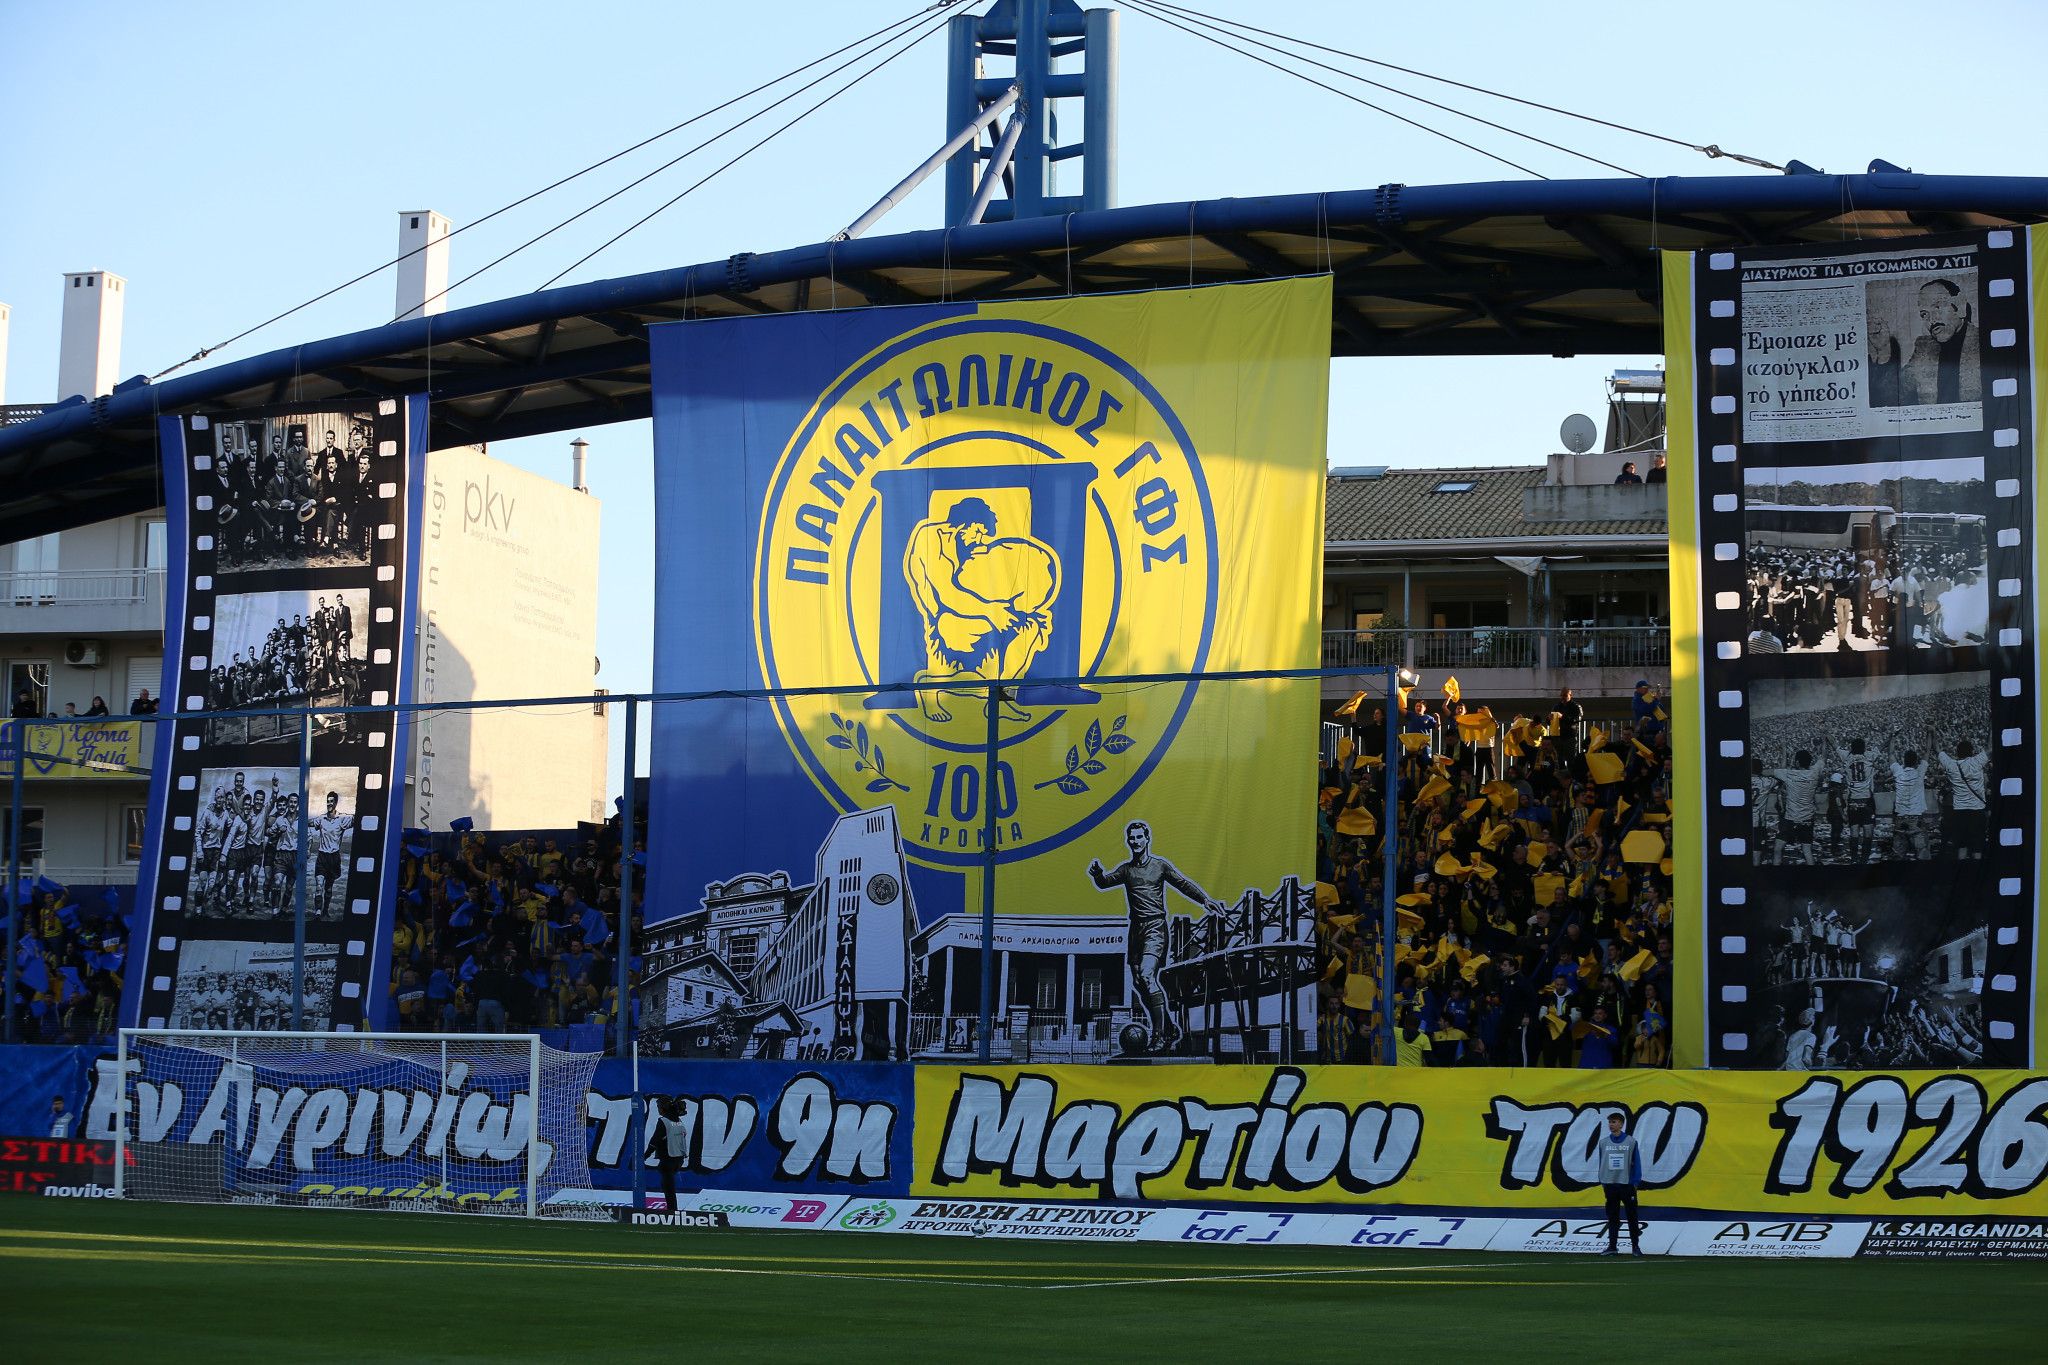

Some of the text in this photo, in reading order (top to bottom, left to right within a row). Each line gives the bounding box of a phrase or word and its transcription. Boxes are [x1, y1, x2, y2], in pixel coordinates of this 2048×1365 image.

[1741, 255, 1972, 281] ΔΙΑΣΥΡΜΟΣ ΓΙΑ ΤΟ ΚΟΜΜΕΝΟ ΑΥΤΙ
[1778, 381, 1856, 408] γήπεδο!
[785, 354, 1188, 586] ΠΑΝΑΙΤΩΛΙΚΟΣ ΓΦΣ
[69, 723, 133, 746] Χρόνια
[77, 745, 130, 772] Πολλά
[1849, 761, 1865, 781] 18
[924, 760, 1019, 824] 100
[919, 821, 1024, 848] ΧΡΟΝΙΑ
[717, 904, 774, 919] ΑΠΟΘΗΚΑΙ ΚΑΠΝΩΝ
[958, 932, 1124, 945] ΠΑΠΑΣΑΤΕΙΟ ΑΡΧΑΙΟΛΟΓΙΚΟ ΜΟΥΣΕΙΟ
[839, 916, 854, 1037] ΚΑΤΑΛΗΨΗ
[942, 1068, 1423, 1199] Μαρτίου
[1490, 1096, 1705, 1191] του
[1774, 1074, 2048, 1199] 1926
[44, 1183, 126, 1199] novibe
[631, 1211, 719, 1227] novibet
[699, 1203, 782, 1215] COSMOTE
[910, 1203, 1157, 1225] ΕΝΩΣΗ ΑΓΡΙΝΙΟΥ
[898, 1219, 1141, 1238] ΑΓΡΟΤΙΚΣ ΣΥΝΕΤΑΙΡΙΣΜΟΣ
[1181, 1223, 1248, 1241] taf
[1351, 1228, 1419, 1246] taf
[1531, 1219, 1649, 1239] A4B
[1713, 1222, 1833, 1242] A4B
[1871, 1222, 1892, 1236] K.
[1566, 1240, 1634, 1248] BUILDIGS
[1867, 1239, 2048, 1249] ΥΔΡΕΥΣΗ ΑΡΔΕΥΣΗ ΘΕΡΜΑΝΣΗ
